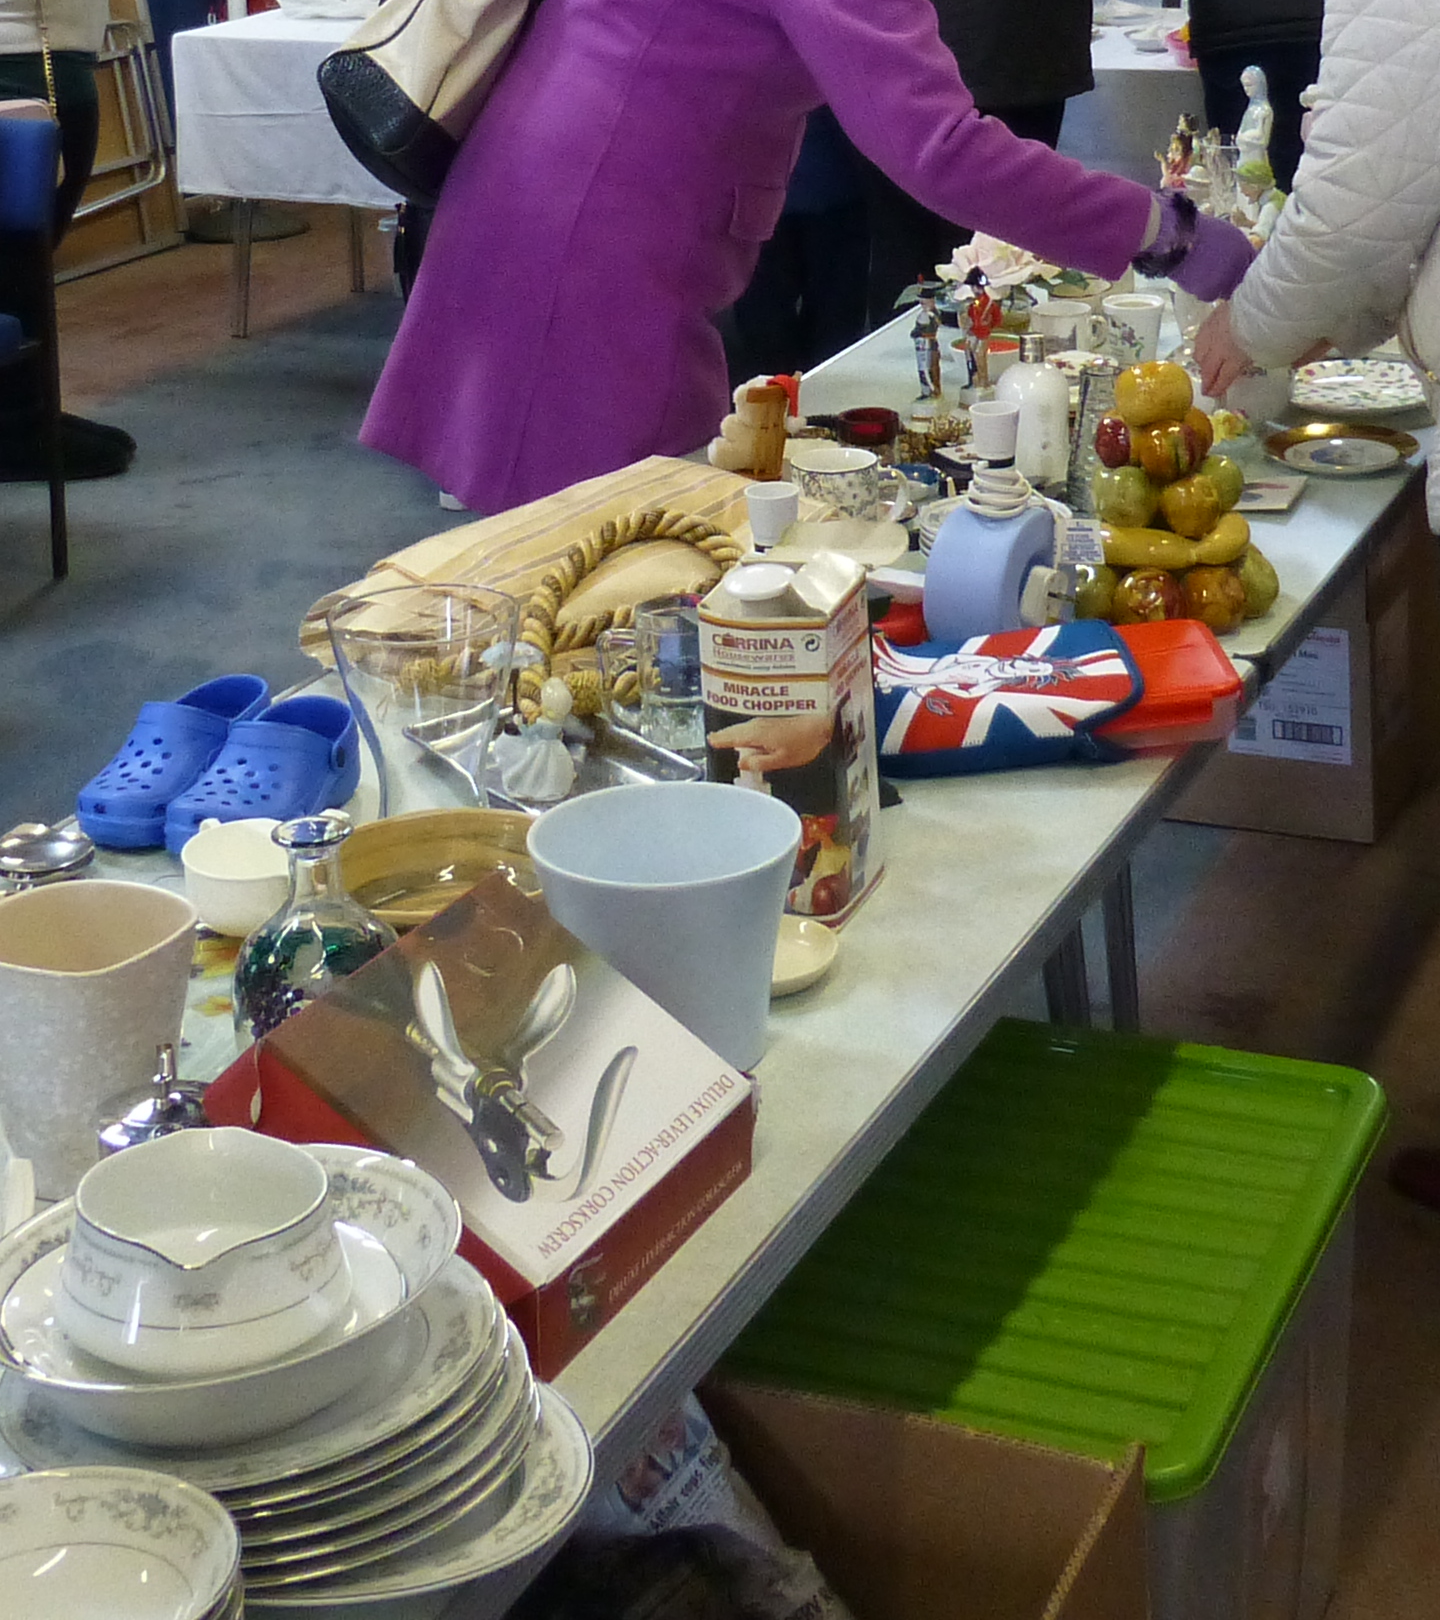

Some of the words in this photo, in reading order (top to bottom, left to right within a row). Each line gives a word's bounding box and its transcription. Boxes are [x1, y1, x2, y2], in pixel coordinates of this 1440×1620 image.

[706, 690, 739, 707] FOOD
[742, 698, 817, 711] CHOPPER
[723, 682, 789, 697] MIRACLE
[688, 1073, 736, 1118] DELUXE
[611, 1112, 695, 1192] LEVER-ACTION
[537, 1184, 616, 1260] CORKSCREW
